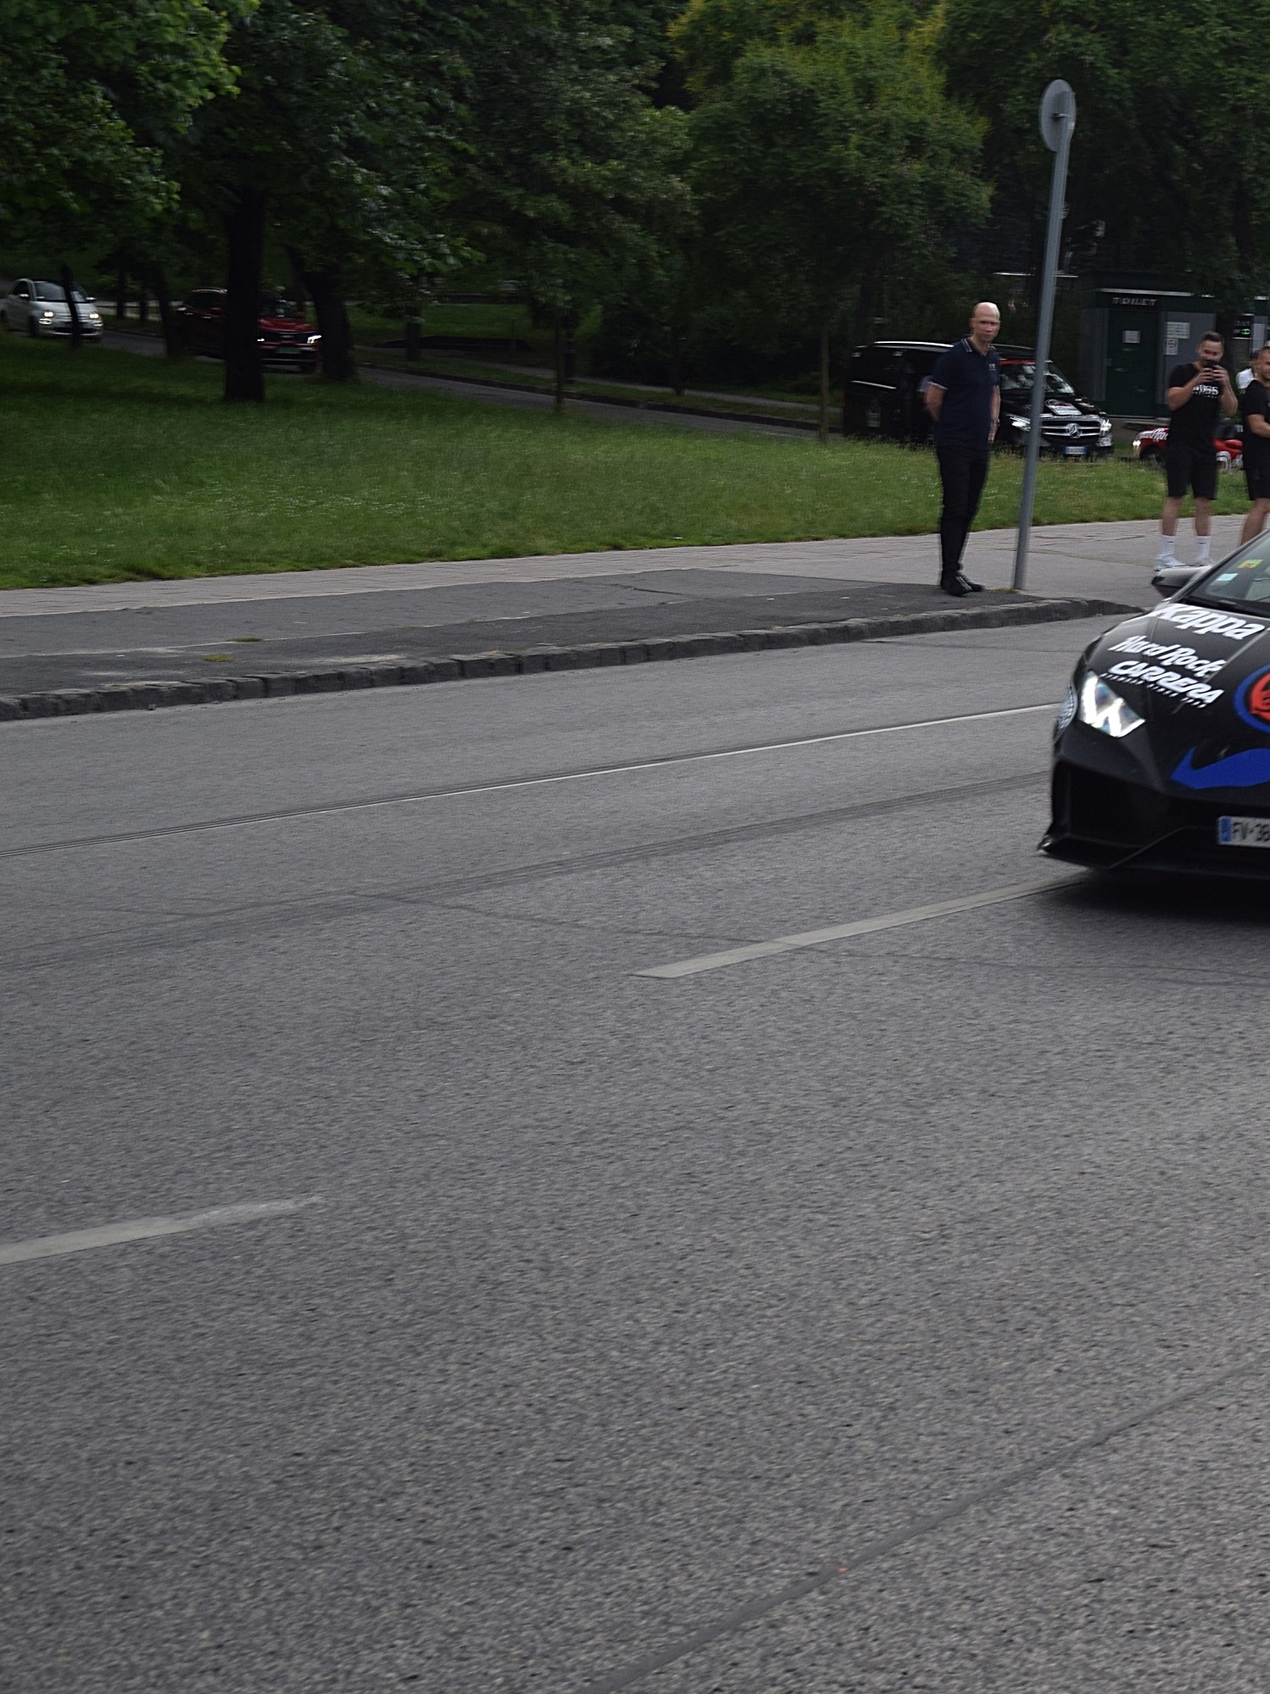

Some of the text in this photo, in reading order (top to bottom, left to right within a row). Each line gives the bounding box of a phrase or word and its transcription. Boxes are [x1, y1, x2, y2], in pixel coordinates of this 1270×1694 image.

[1111, 296, 1158, 306] TOILET
[1154, 602, 1266, 641] Kappa
[1106, 635, 1228, 678] Hard Rock
[1107, 660, 1225, 705] CARRERA
